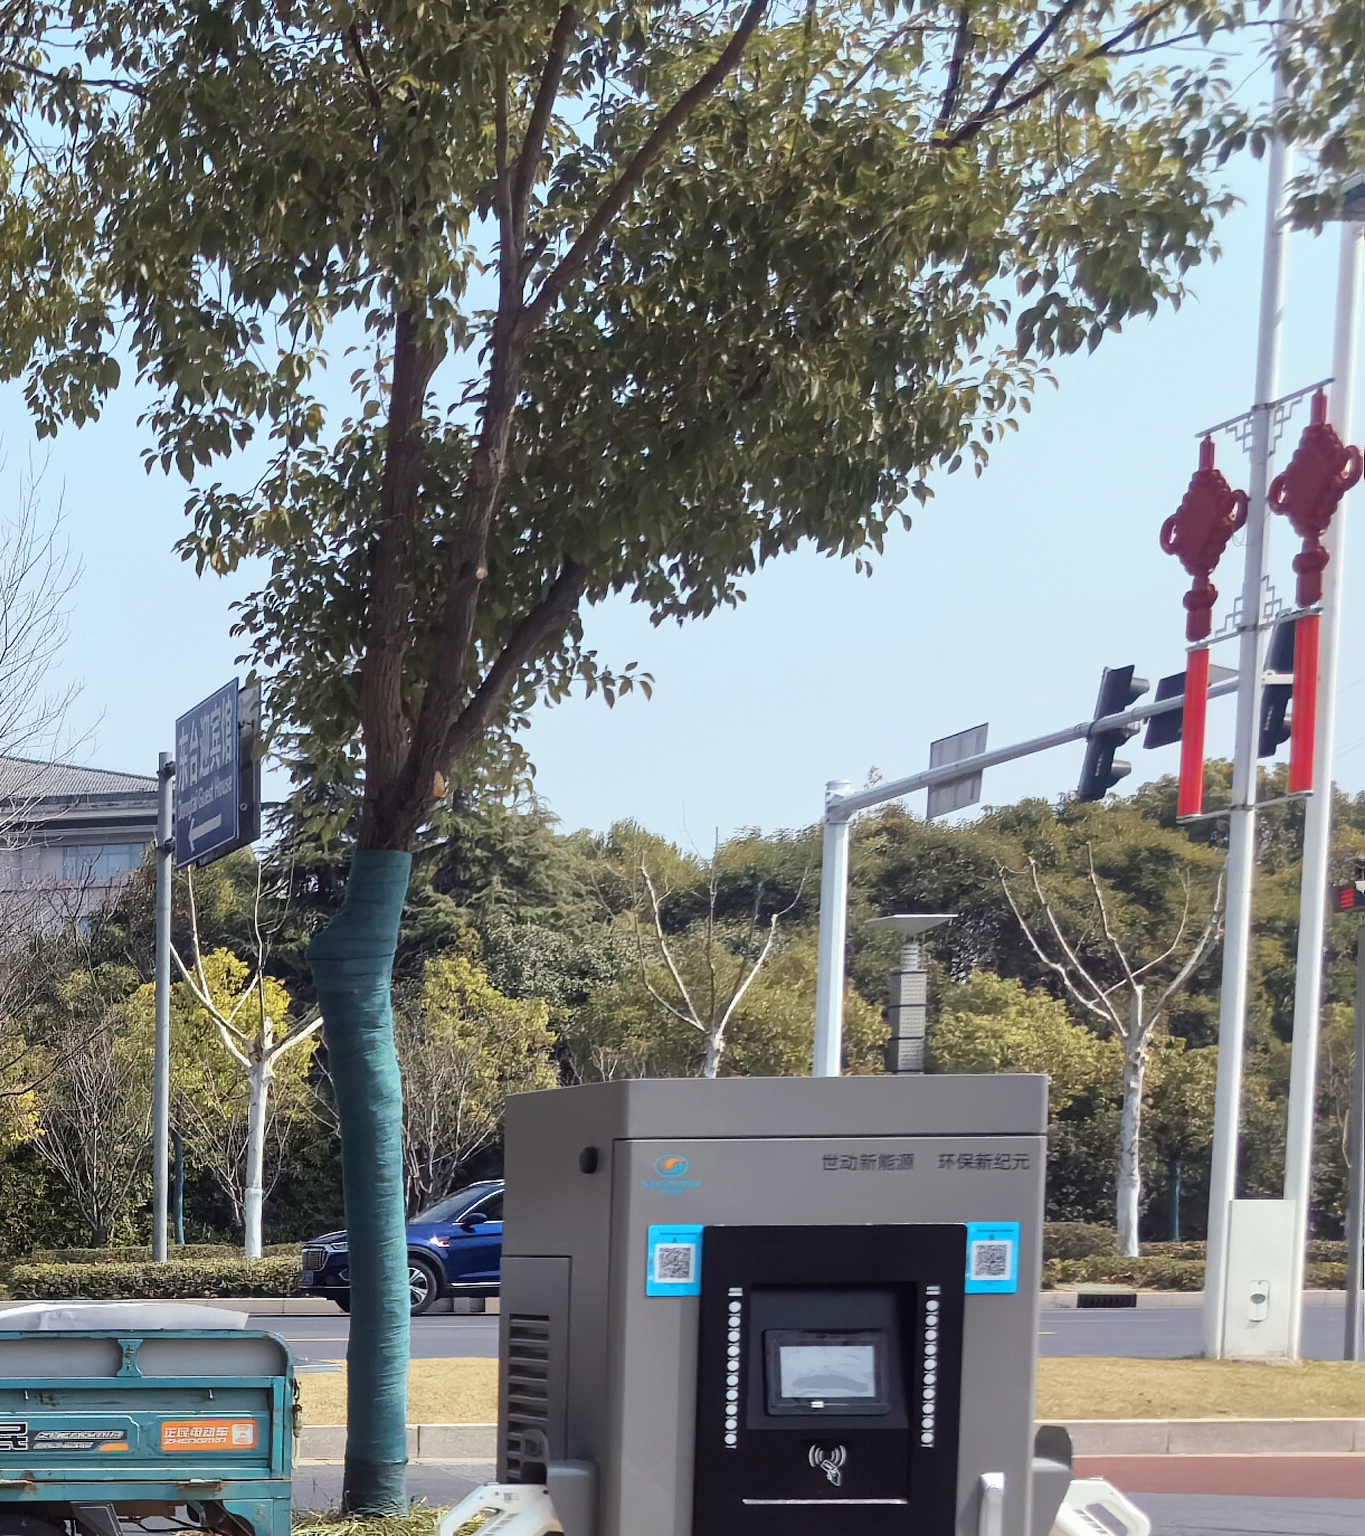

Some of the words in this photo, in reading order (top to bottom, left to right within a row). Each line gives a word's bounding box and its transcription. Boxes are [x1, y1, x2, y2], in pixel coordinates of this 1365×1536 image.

[821, 1153, 915, 1171] 世动新能源
[937, 1153, 1031, 1171] 环保新纪元
